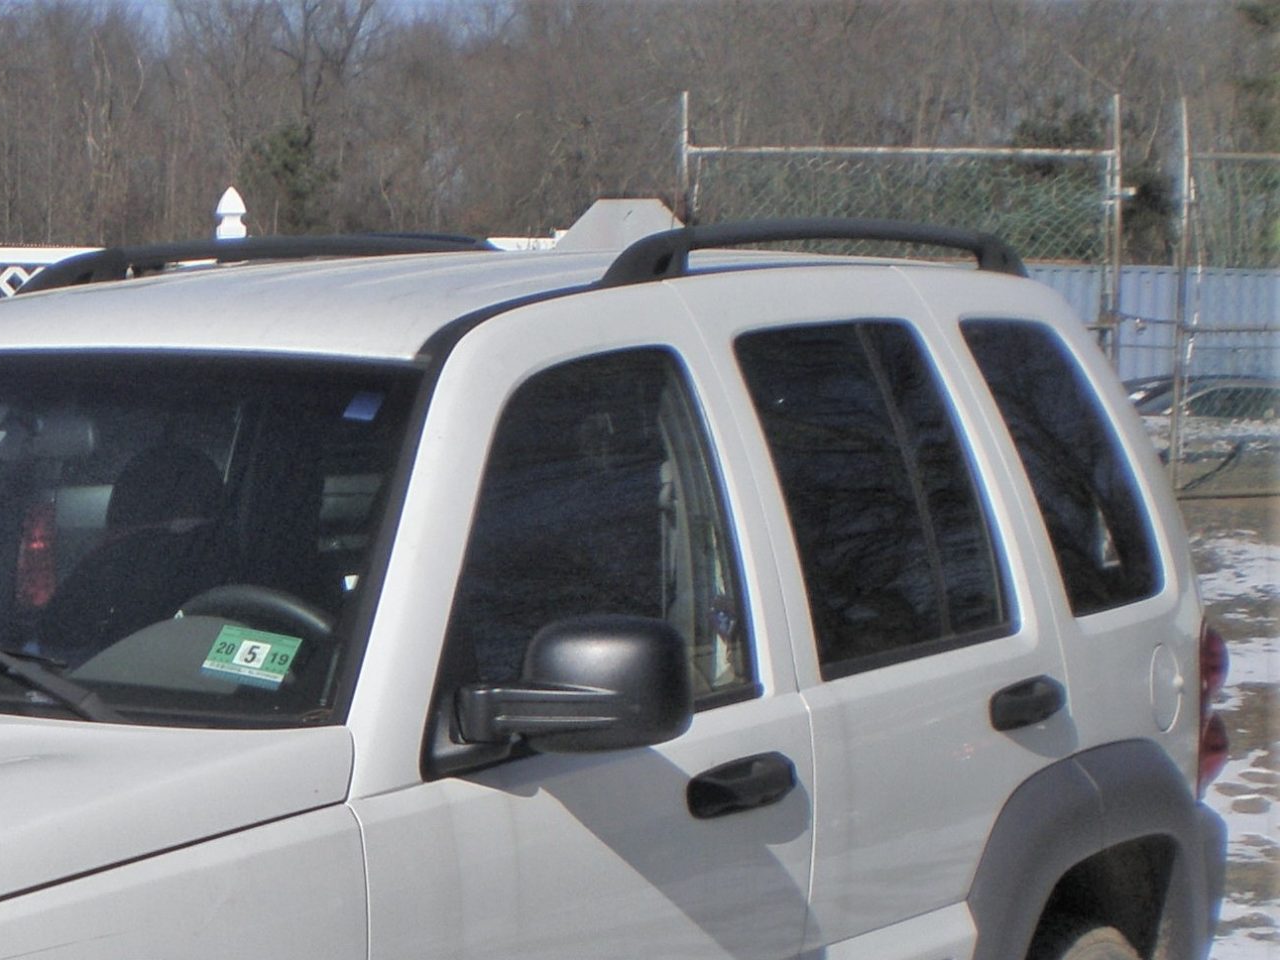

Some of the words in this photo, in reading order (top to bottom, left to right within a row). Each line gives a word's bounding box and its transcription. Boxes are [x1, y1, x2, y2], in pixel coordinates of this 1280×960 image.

[216, 642, 236, 656] 20
[243, 645, 261, 664] 5
[270, 652, 290, 666] 19
